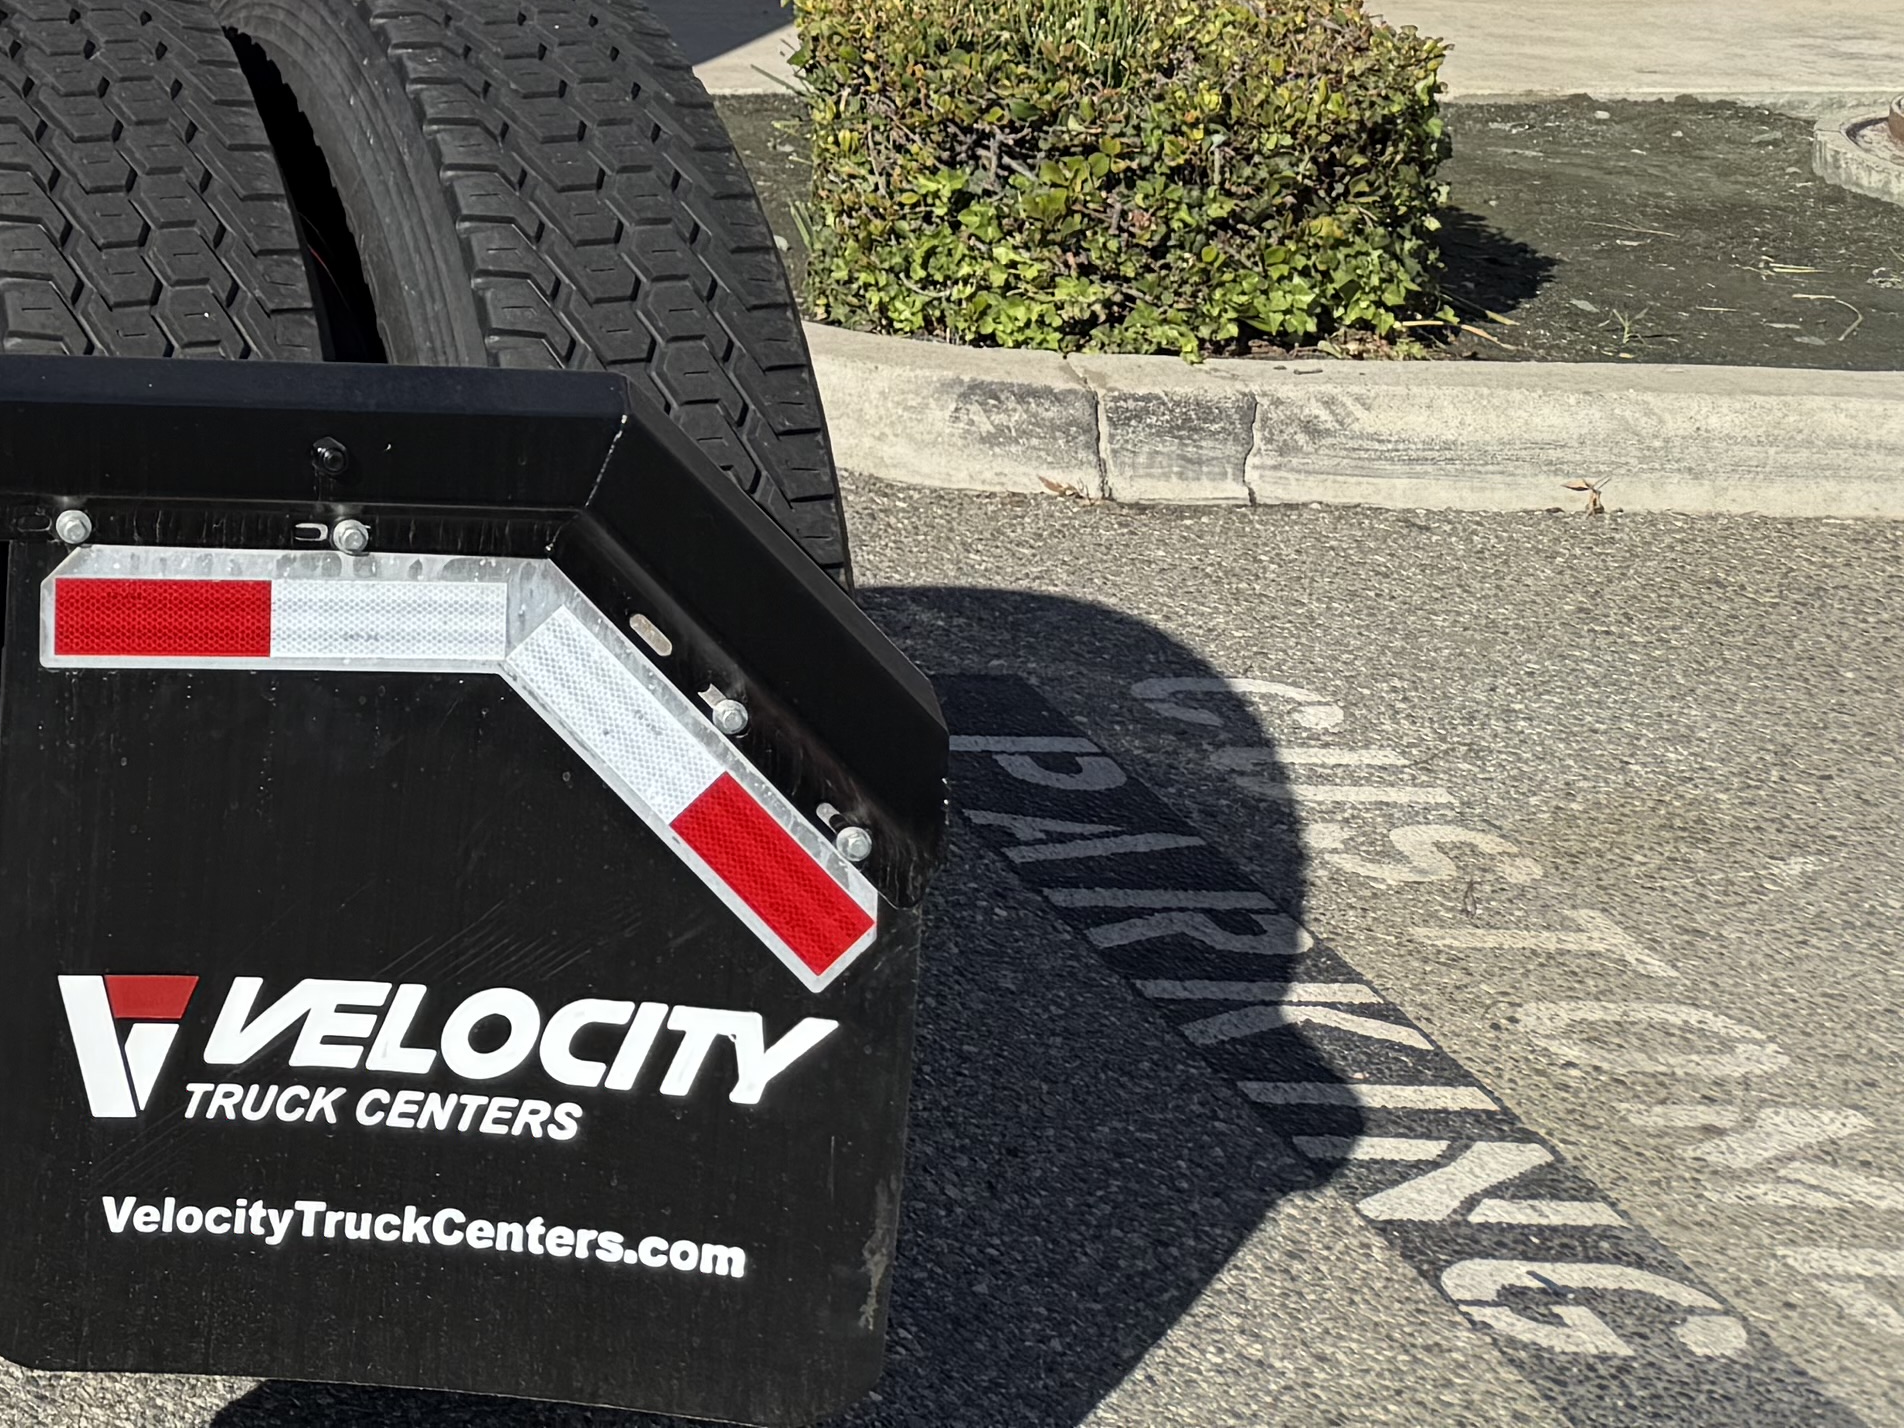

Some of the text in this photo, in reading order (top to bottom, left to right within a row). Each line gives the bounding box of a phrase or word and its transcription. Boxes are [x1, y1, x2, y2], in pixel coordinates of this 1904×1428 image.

[203, 976, 840, 1105] VELOCITY
[949, 734, 1748, 1356] PARKING
[184, 1082, 584, 1141] TRUCK CENTERS
[101, 1195, 747, 1279] VelocityTruckCenters.com
